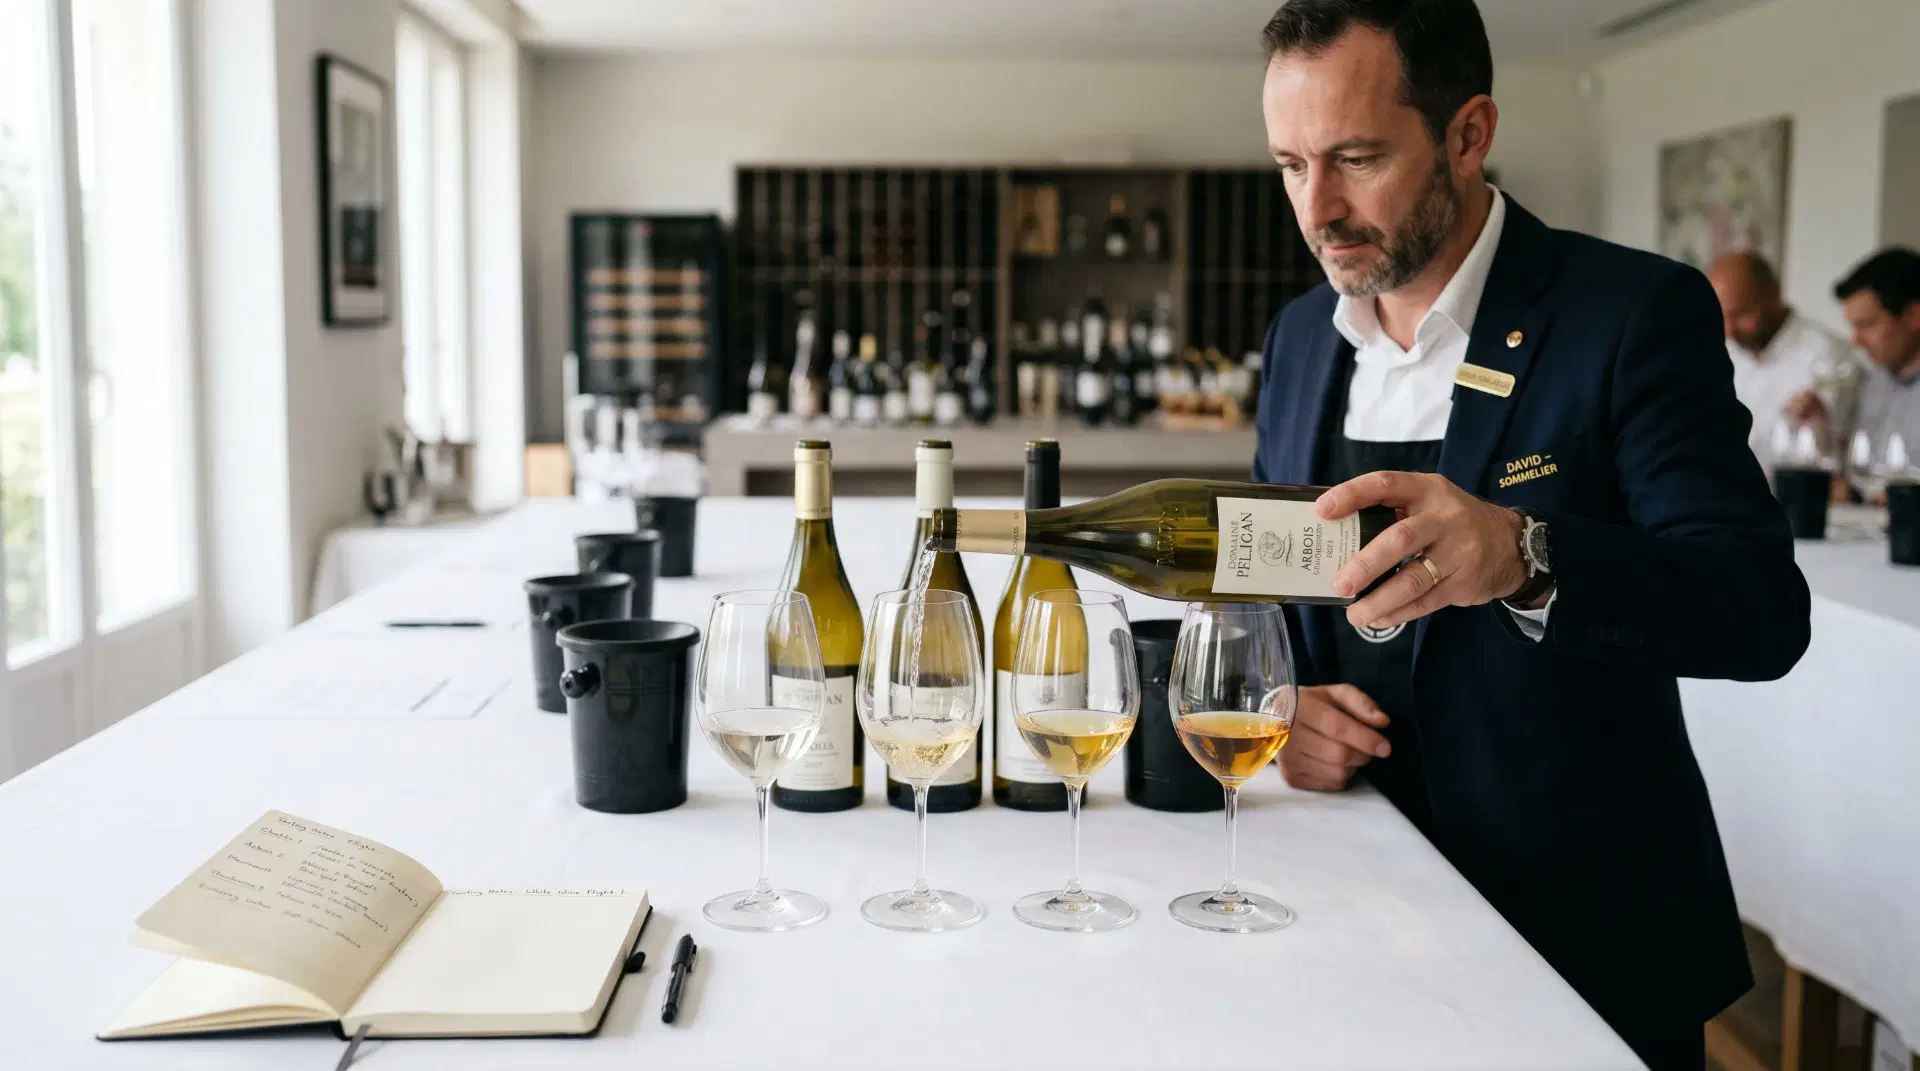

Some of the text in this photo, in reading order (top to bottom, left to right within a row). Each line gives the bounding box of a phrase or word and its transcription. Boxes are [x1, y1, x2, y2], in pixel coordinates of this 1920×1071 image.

[1499, 464, 1558, 488] SOMMELIER
[1506, 455, 1541, 473] DAVID
[1228, 520, 1239, 569] DOMAINE
[1301, 526, 1314, 571] ARBOIS
